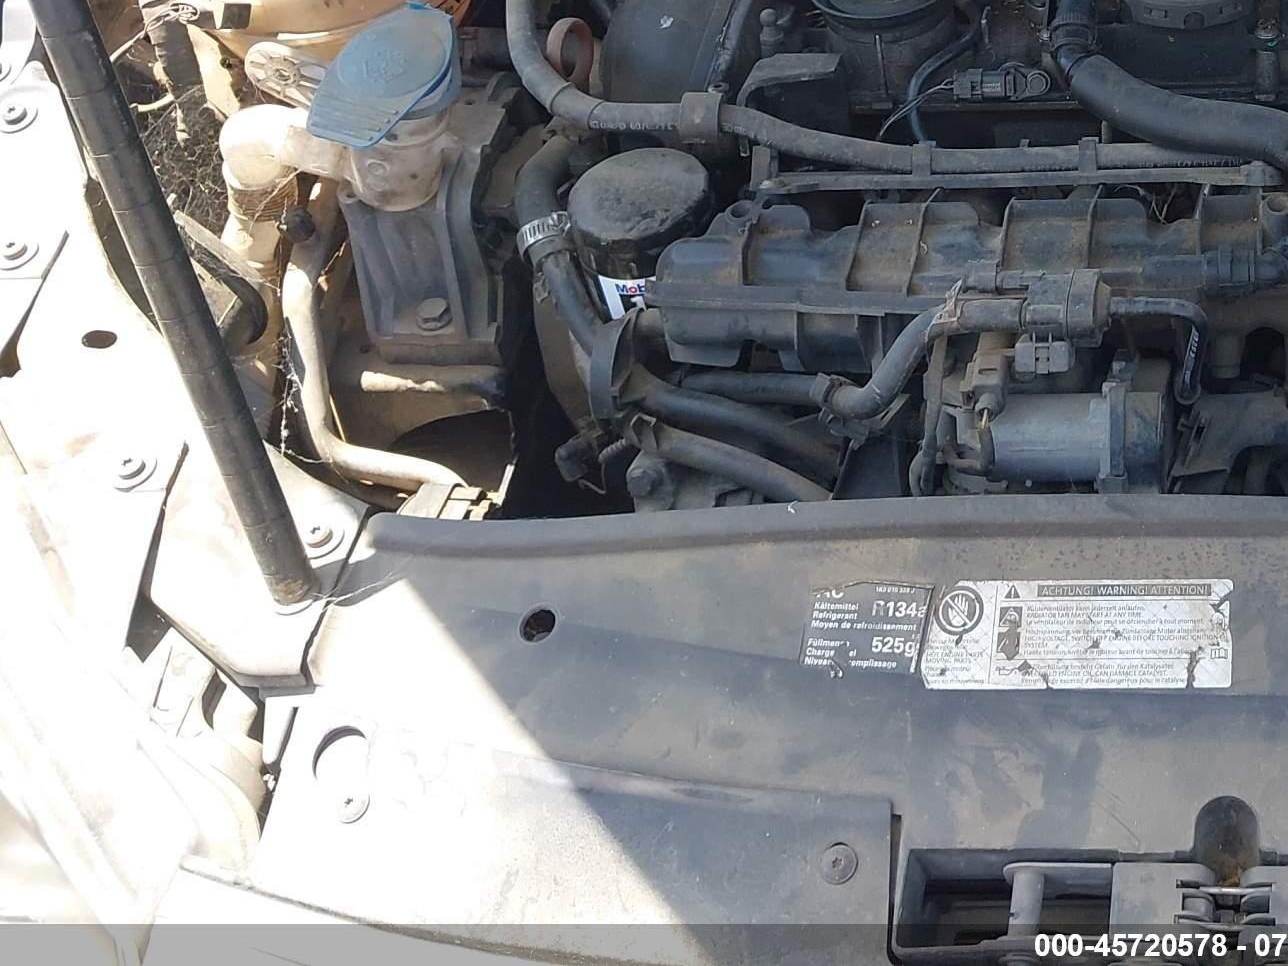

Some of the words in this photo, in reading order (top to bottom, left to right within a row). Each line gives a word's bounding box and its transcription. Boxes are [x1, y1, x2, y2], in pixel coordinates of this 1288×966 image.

[616, 284, 645, 294] Mob
[1041, 586, 1094, 596] ACHTUNG!
[1096, 585, 1148, 595] WARNING!
[1150, 585, 1208, 595] ATTENTION!
[814, 601, 859, 611] Kältemittel
[872, 601, 928, 618] R134a
[813, 611, 858, 620] Refrigerant
[811, 620, 839, 629] Moyen
[841, 621, 851, 629] de
[853, 621, 917, 631] refroidissement
[807, 638, 849, 647] Füllmen
[871, 636, 915, 658] 525g
[806, 648, 835, 657] Charge
[848, 659, 897, 668] emplissage
